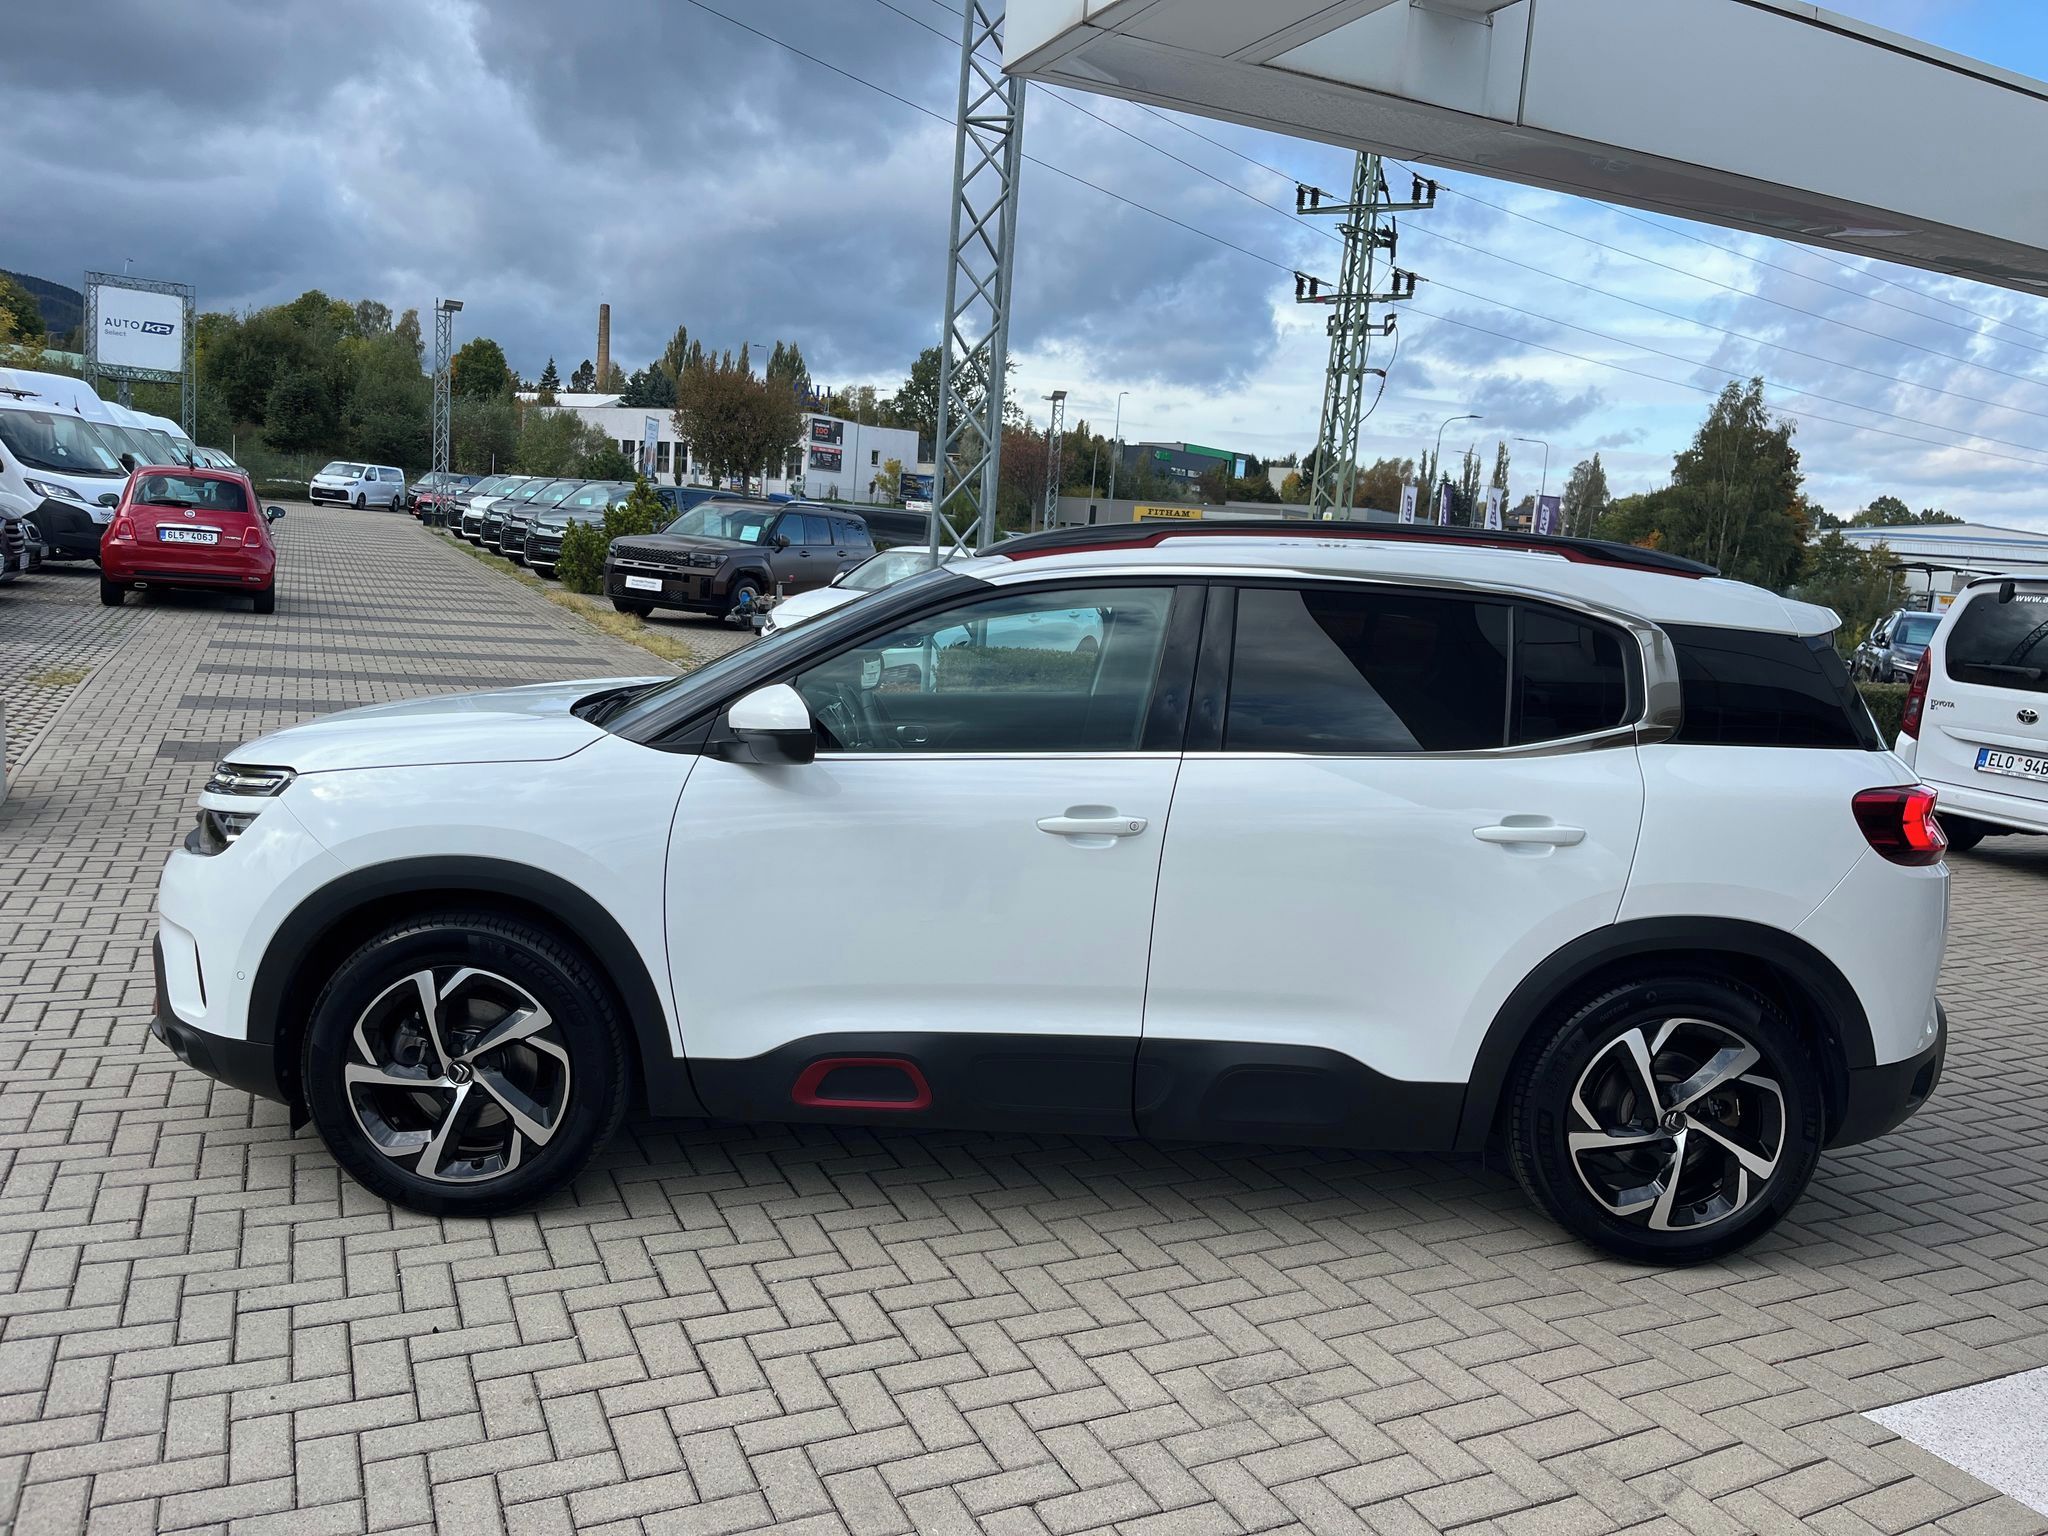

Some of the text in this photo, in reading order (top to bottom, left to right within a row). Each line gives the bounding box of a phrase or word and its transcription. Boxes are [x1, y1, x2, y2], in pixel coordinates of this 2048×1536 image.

[104, 317, 140, 330] AUTO
[104, 329, 127, 337] Select
[1148, 508, 1191, 517] FITHAM
[167, 530, 214, 542] 6L5 4063
[1930, 699, 1955, 709] TOYOTA
